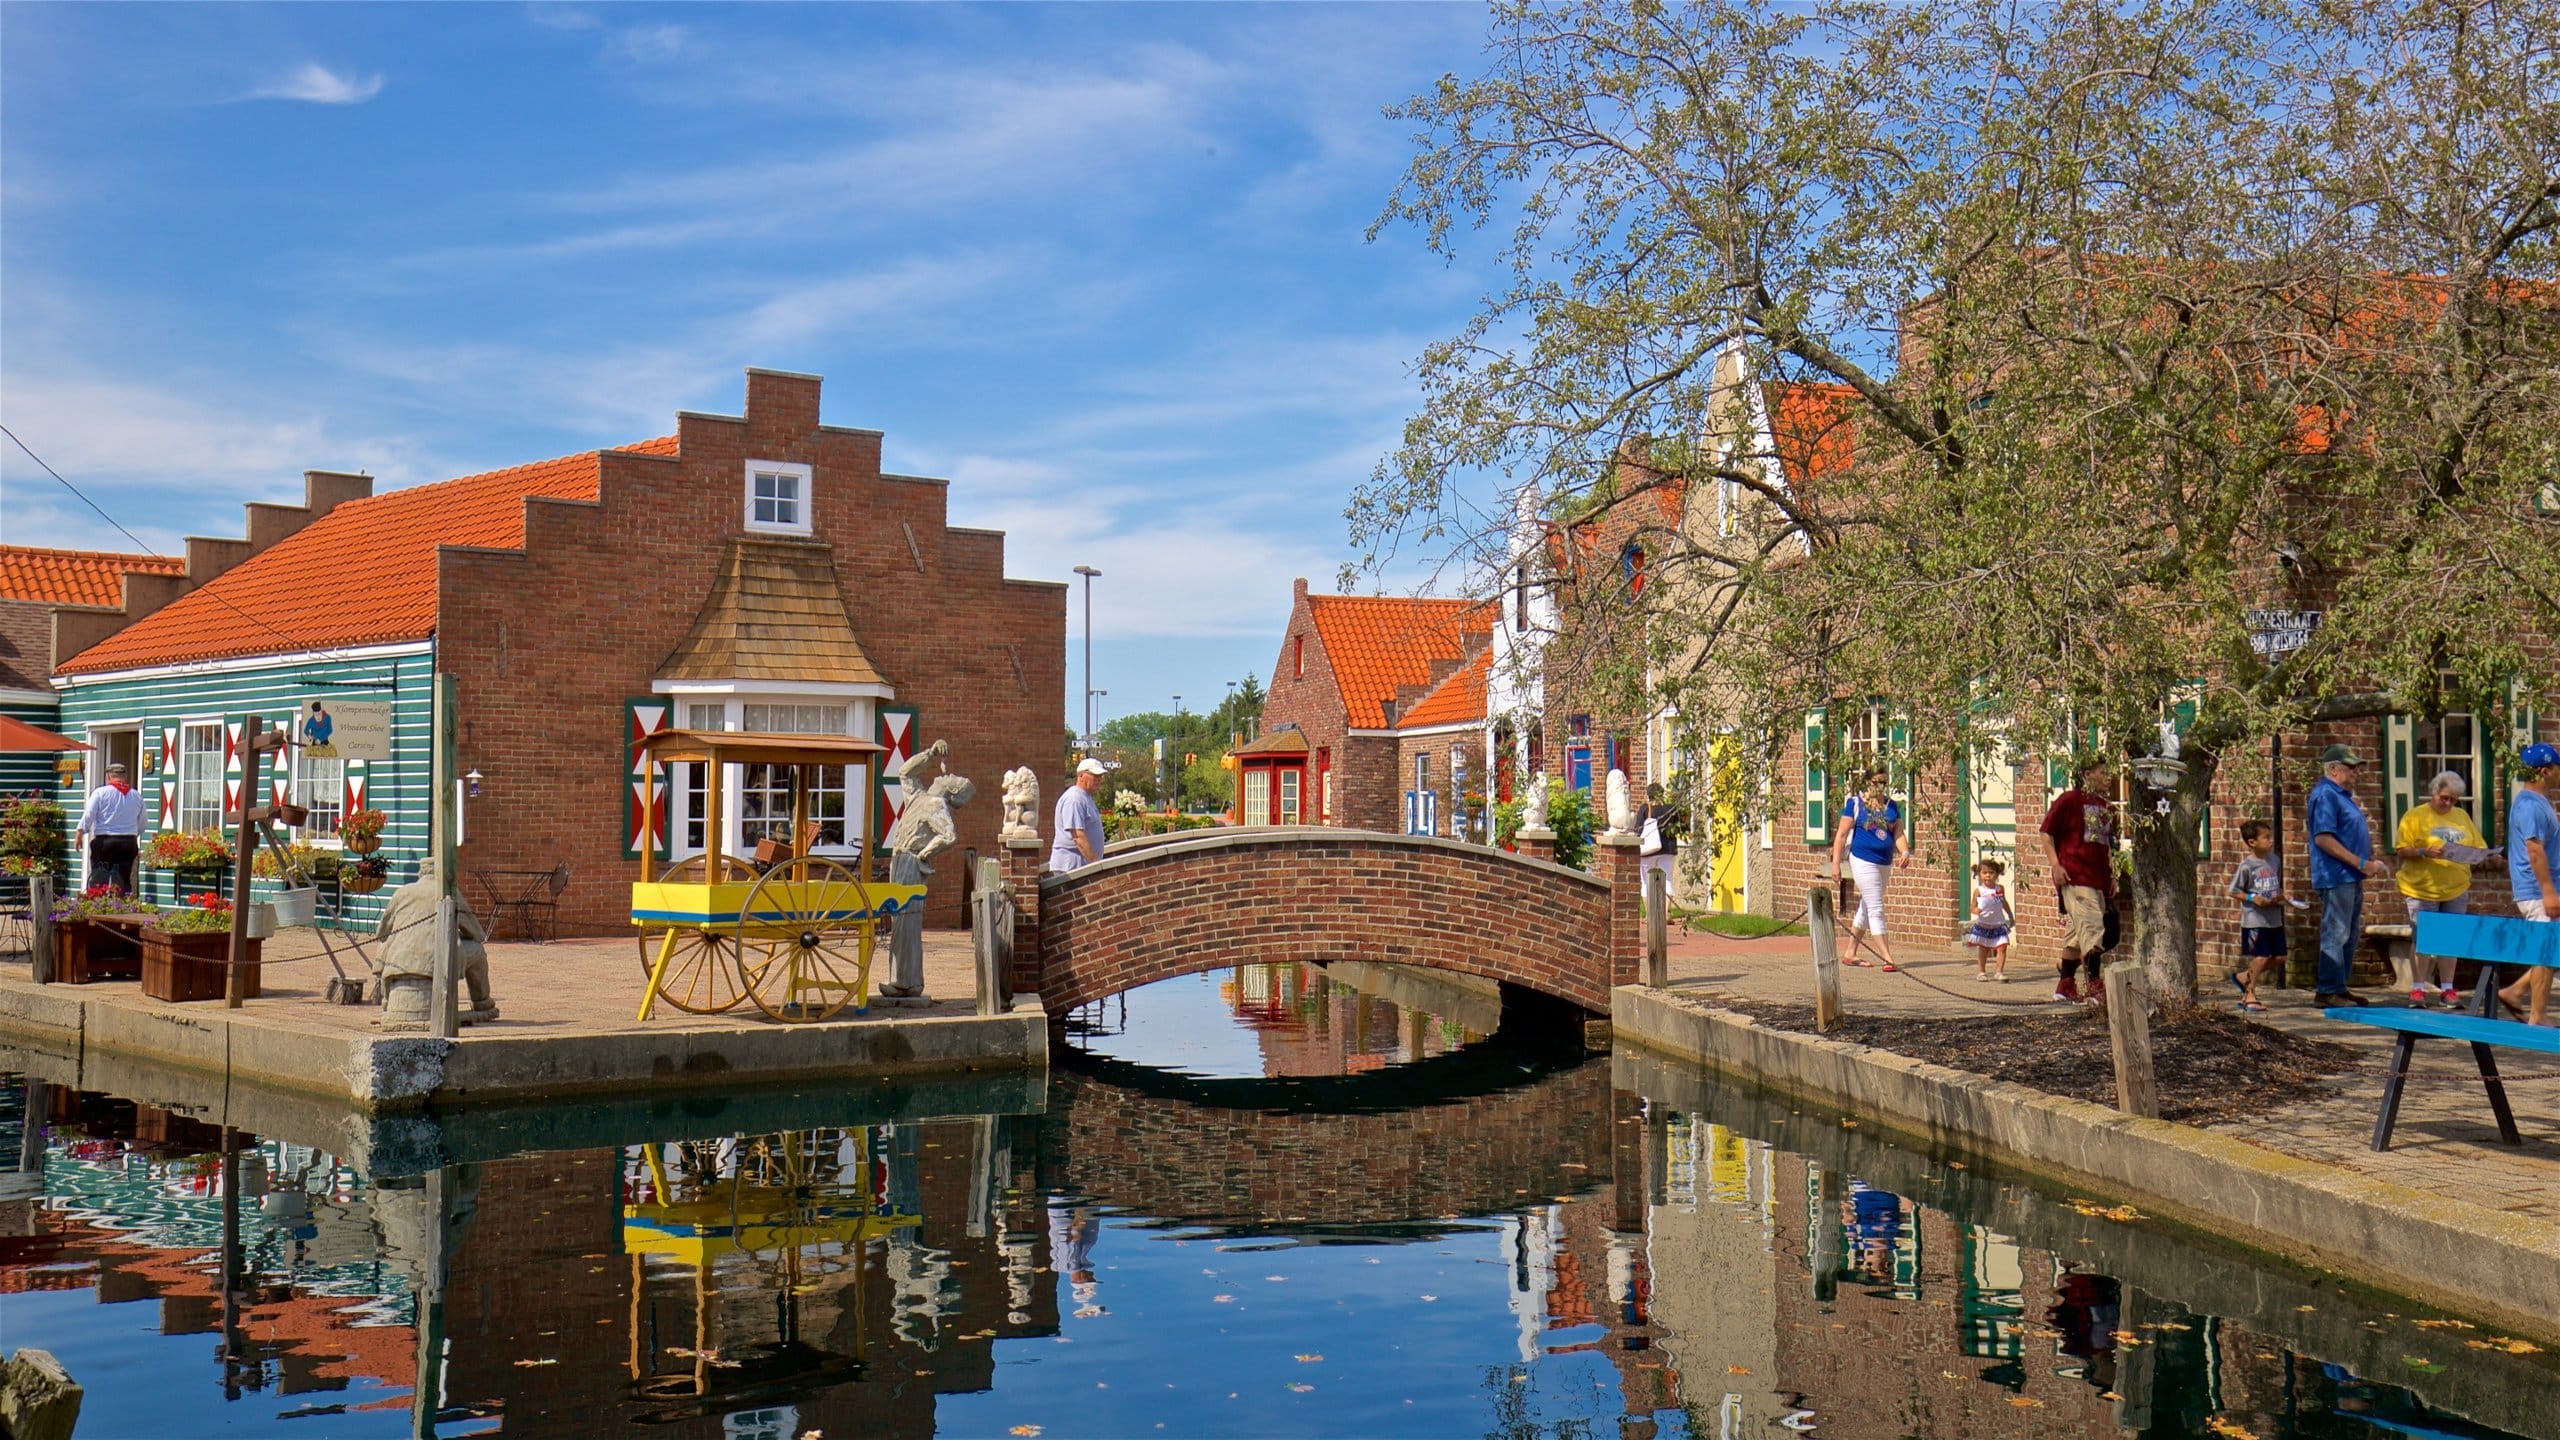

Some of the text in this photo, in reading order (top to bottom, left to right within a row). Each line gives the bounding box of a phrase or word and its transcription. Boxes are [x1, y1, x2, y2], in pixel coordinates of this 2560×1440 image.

[335, 704, 389, 716] Klompenmaker
[340, 723, 367, 731] Wooden
[348, 741, 376, 751] Carving
